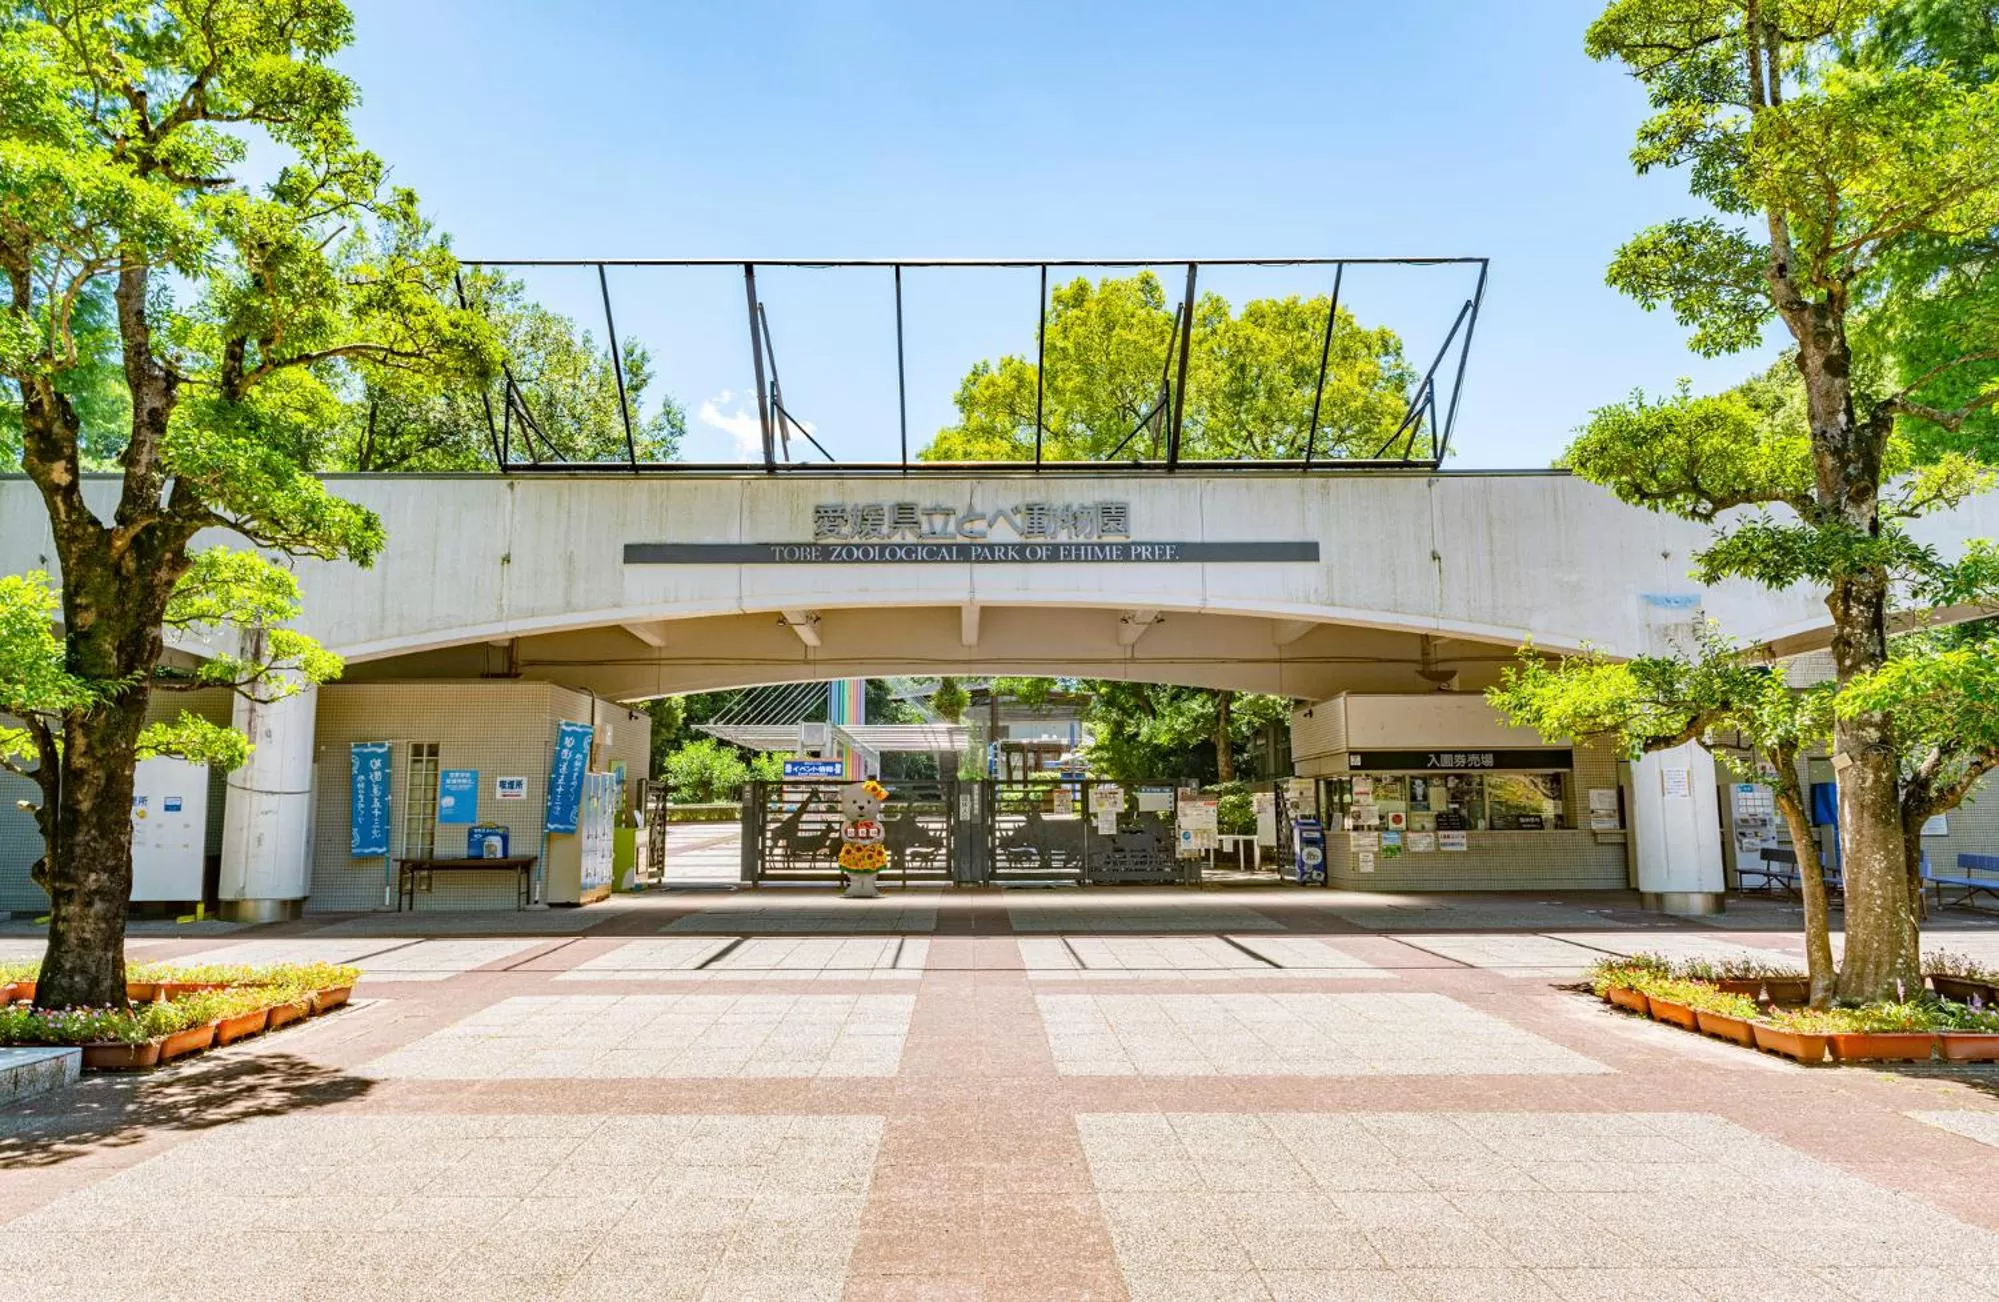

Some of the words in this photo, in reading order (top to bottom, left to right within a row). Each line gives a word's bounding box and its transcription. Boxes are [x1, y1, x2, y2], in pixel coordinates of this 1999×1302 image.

[813, 502, 1131, 540] 愛媛県立とべ動物園
[771, 545, 822, 562] TOBE
[829, 545, 963, 562] ZOOLOGICAL
[971, 545, 1020, 561] PARK
[1025, 545, 1052, 561] OF
[1060, 545, 1124, 561] EHIME
[1131, 545, 1180, 561] PREF.
[1427, 753, 1494, 767] 入園券売場
